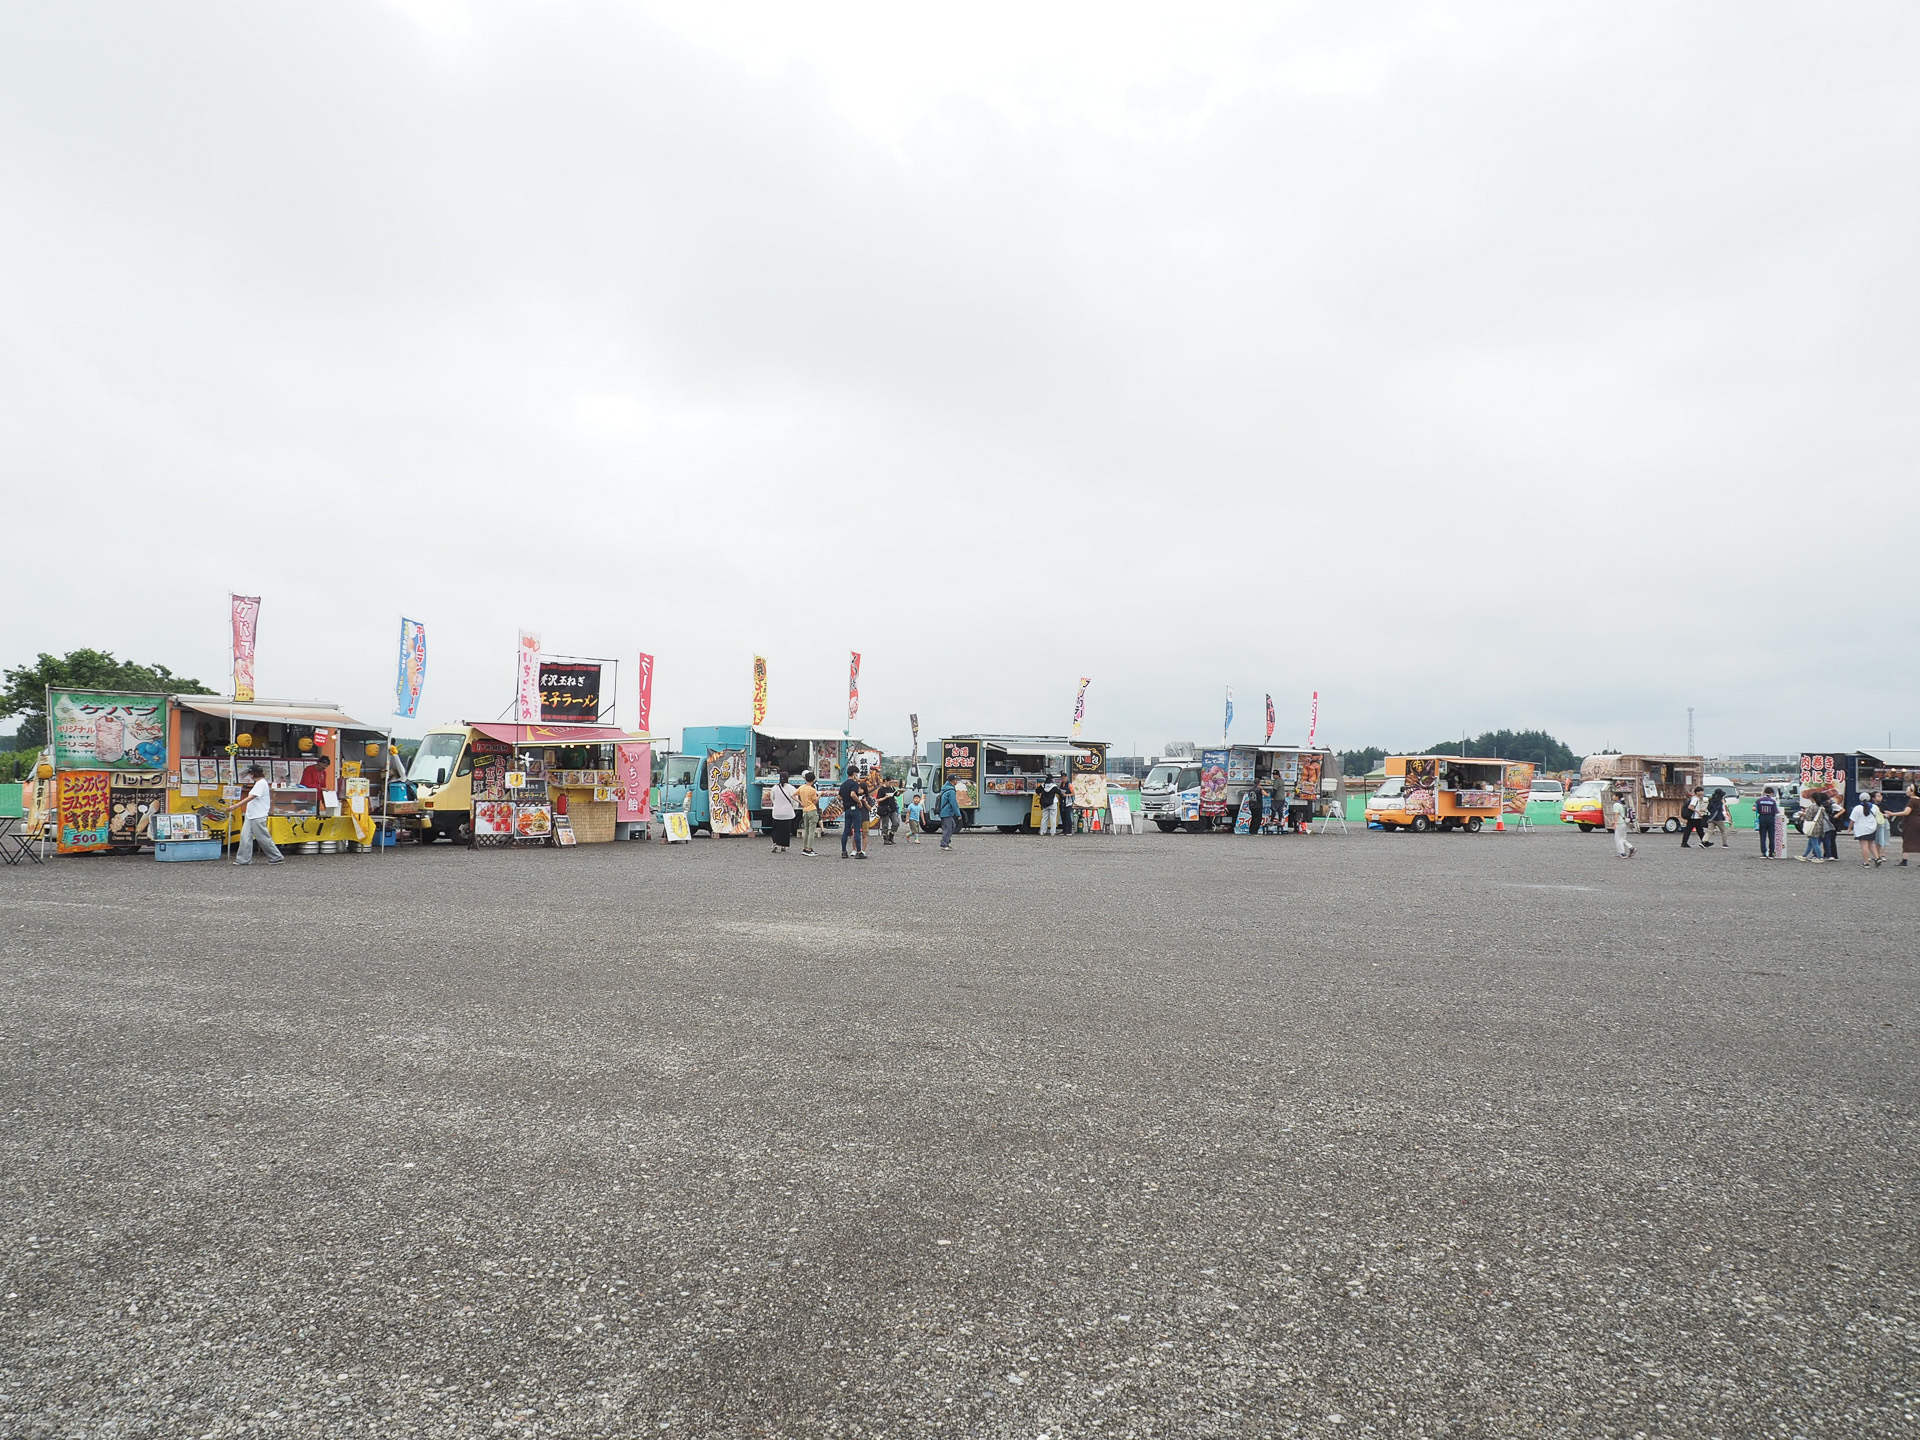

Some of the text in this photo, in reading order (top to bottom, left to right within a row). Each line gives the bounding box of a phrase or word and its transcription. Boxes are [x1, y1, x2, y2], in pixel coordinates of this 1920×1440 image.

[79, 704, 159, 716] ケバブ
[952, 747, 968, 757] 台湾
[945, 757, 975, 767] まぜそば
[1076, 755, 1098, 765] 小包
[1801, 755, 1834, 770] 肉巻き
[114, 773, 163, 786] ハットグ
[627, 752, 639, 812] いちご飴
[1800, 769, 1846, 783] おにぎり
[71, 834, 97, 845] 500
